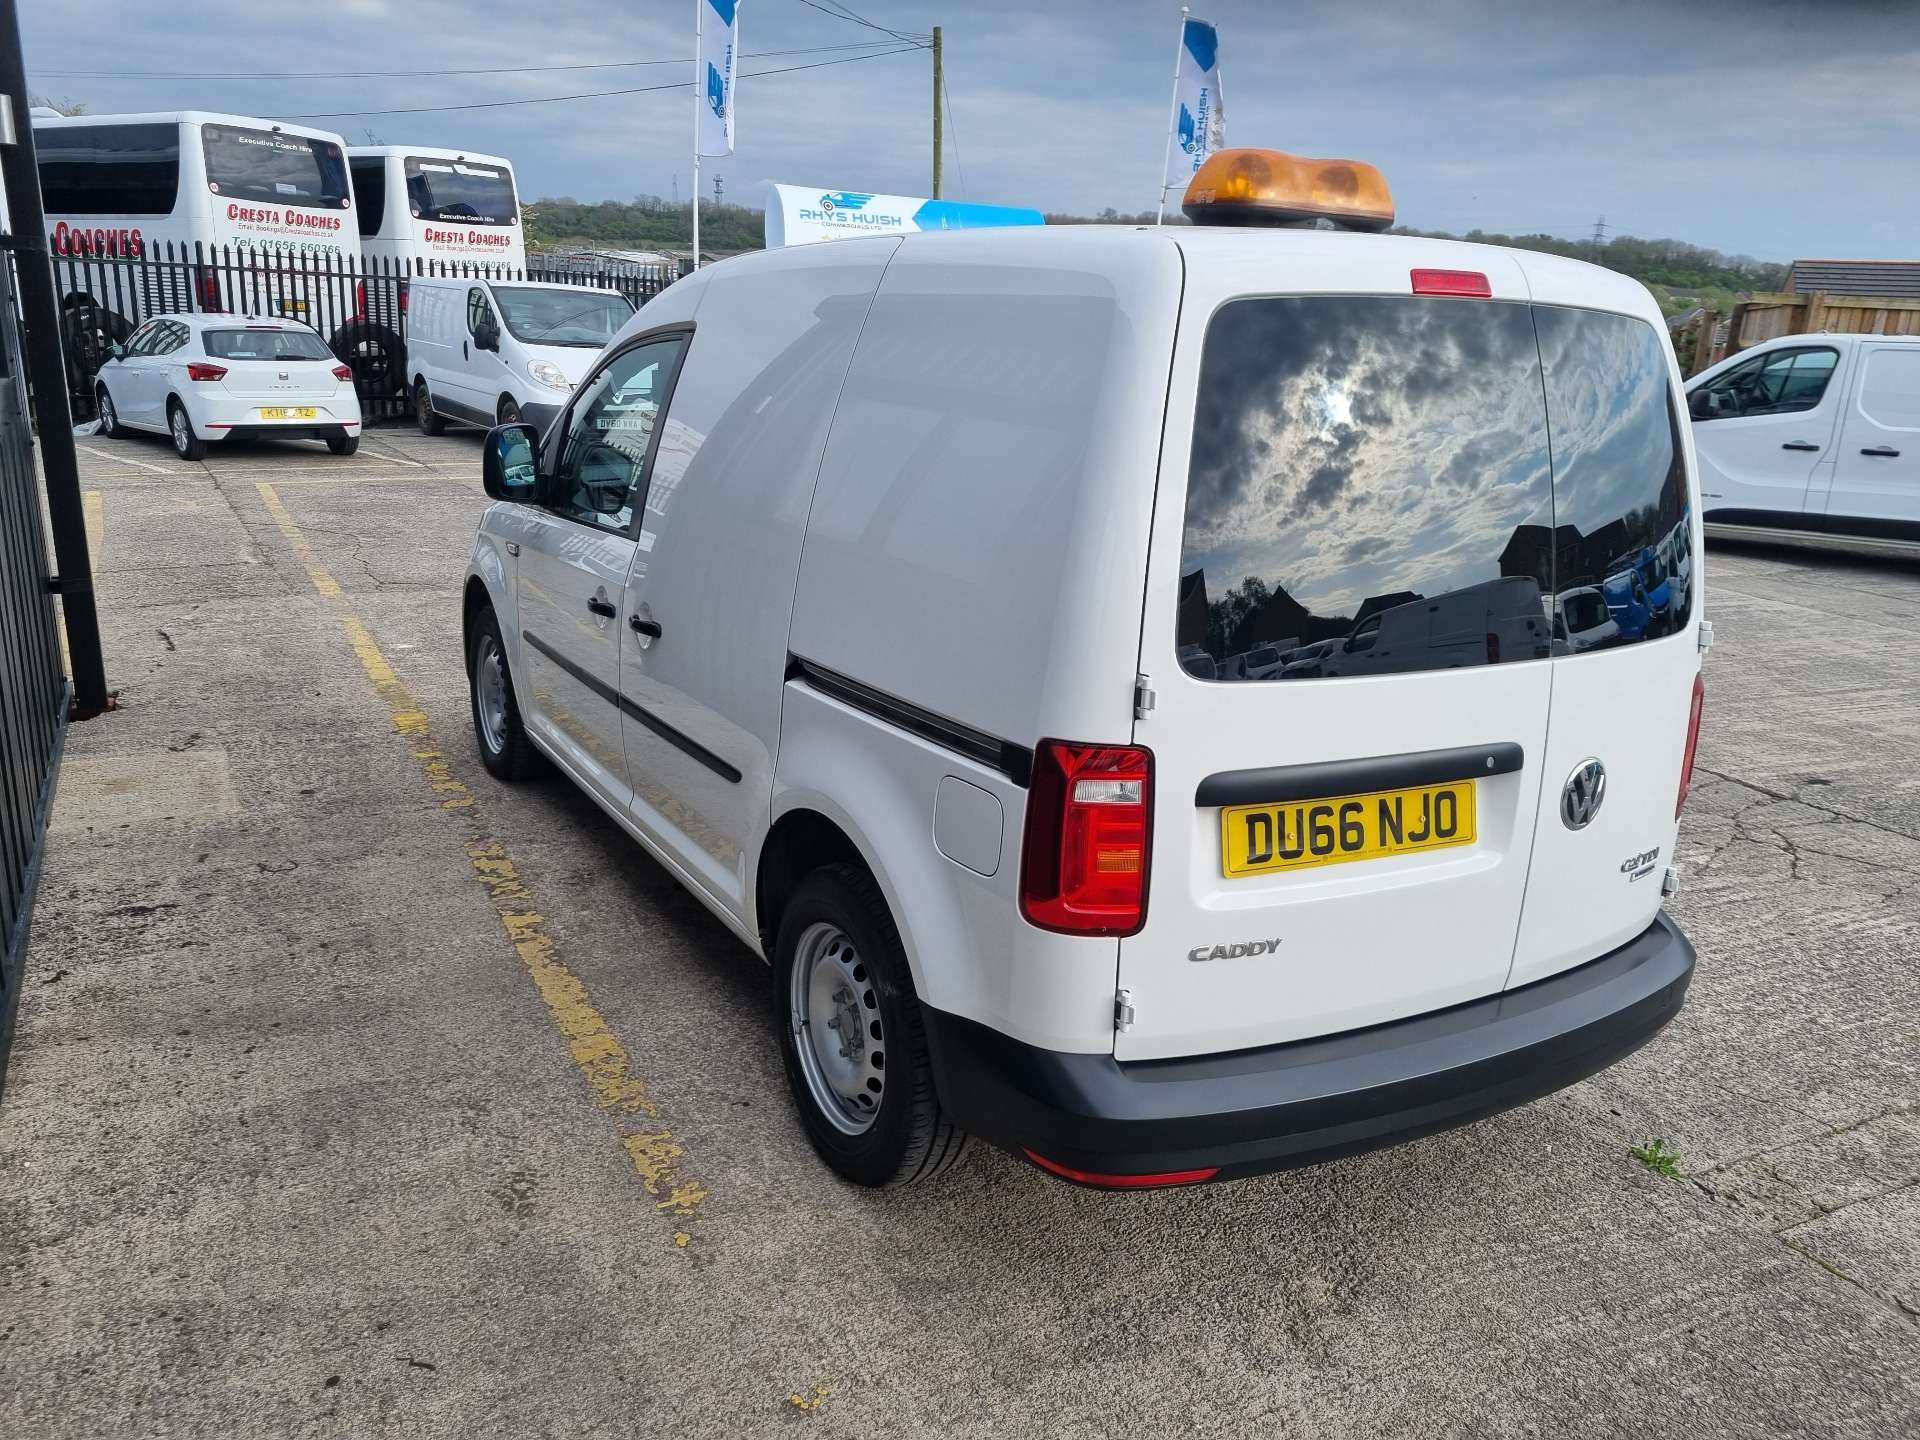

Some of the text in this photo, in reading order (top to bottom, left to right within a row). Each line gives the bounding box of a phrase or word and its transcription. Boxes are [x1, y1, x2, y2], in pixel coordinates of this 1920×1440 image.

[239, 136, 274, 147] Executive
[275, 141, 297, 151] Coach
[227, 203, 341, 230] CRESTA COACHES
[800, 209, 902, 226] RHYS HUISH
[55, 221, 142, 257] COACHES
[260, 239, 297, 251] 01656
[300, 243, 341, 254] 660366
[425, 227, 511, 247] CRESTA COACHES
[1246, 791, 1457, 864] DU66 NJO
[1188, 938, 1283, 962] CADDY
